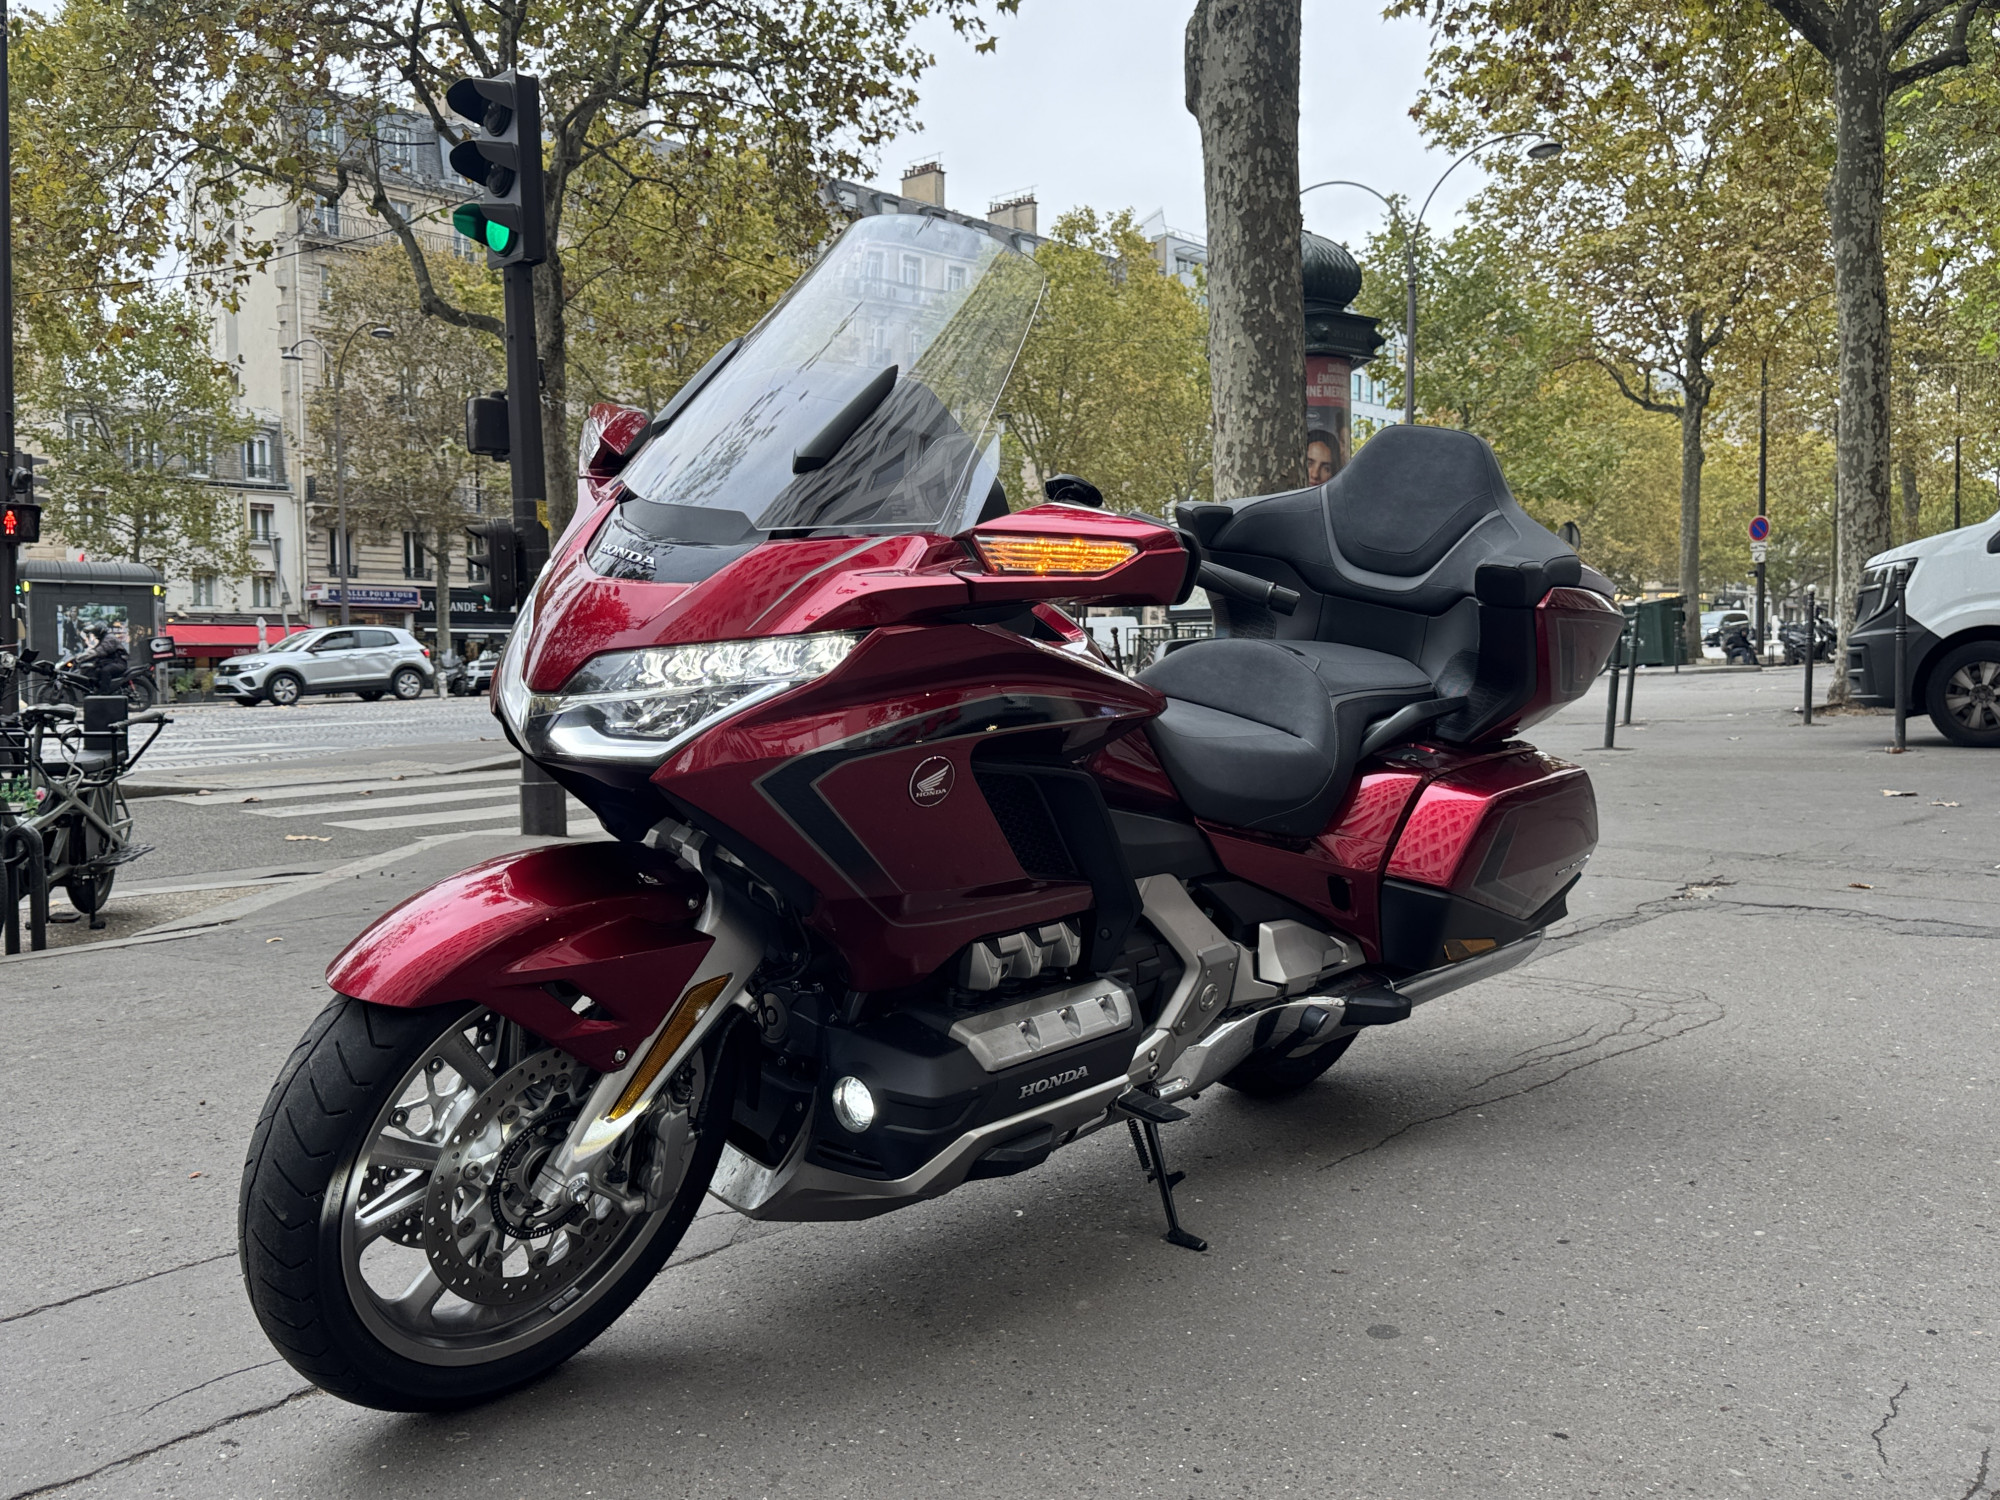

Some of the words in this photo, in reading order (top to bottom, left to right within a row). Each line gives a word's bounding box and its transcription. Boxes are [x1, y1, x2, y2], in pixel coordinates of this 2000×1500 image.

[600, 542, 656, 568] HONDA
[393, 591, 414, 599] TOUS
[421, 602, 435, 611] LA
[916, 788, 947, 798] HONDA
[1018, 1065, 1089, 1100] HONDA
